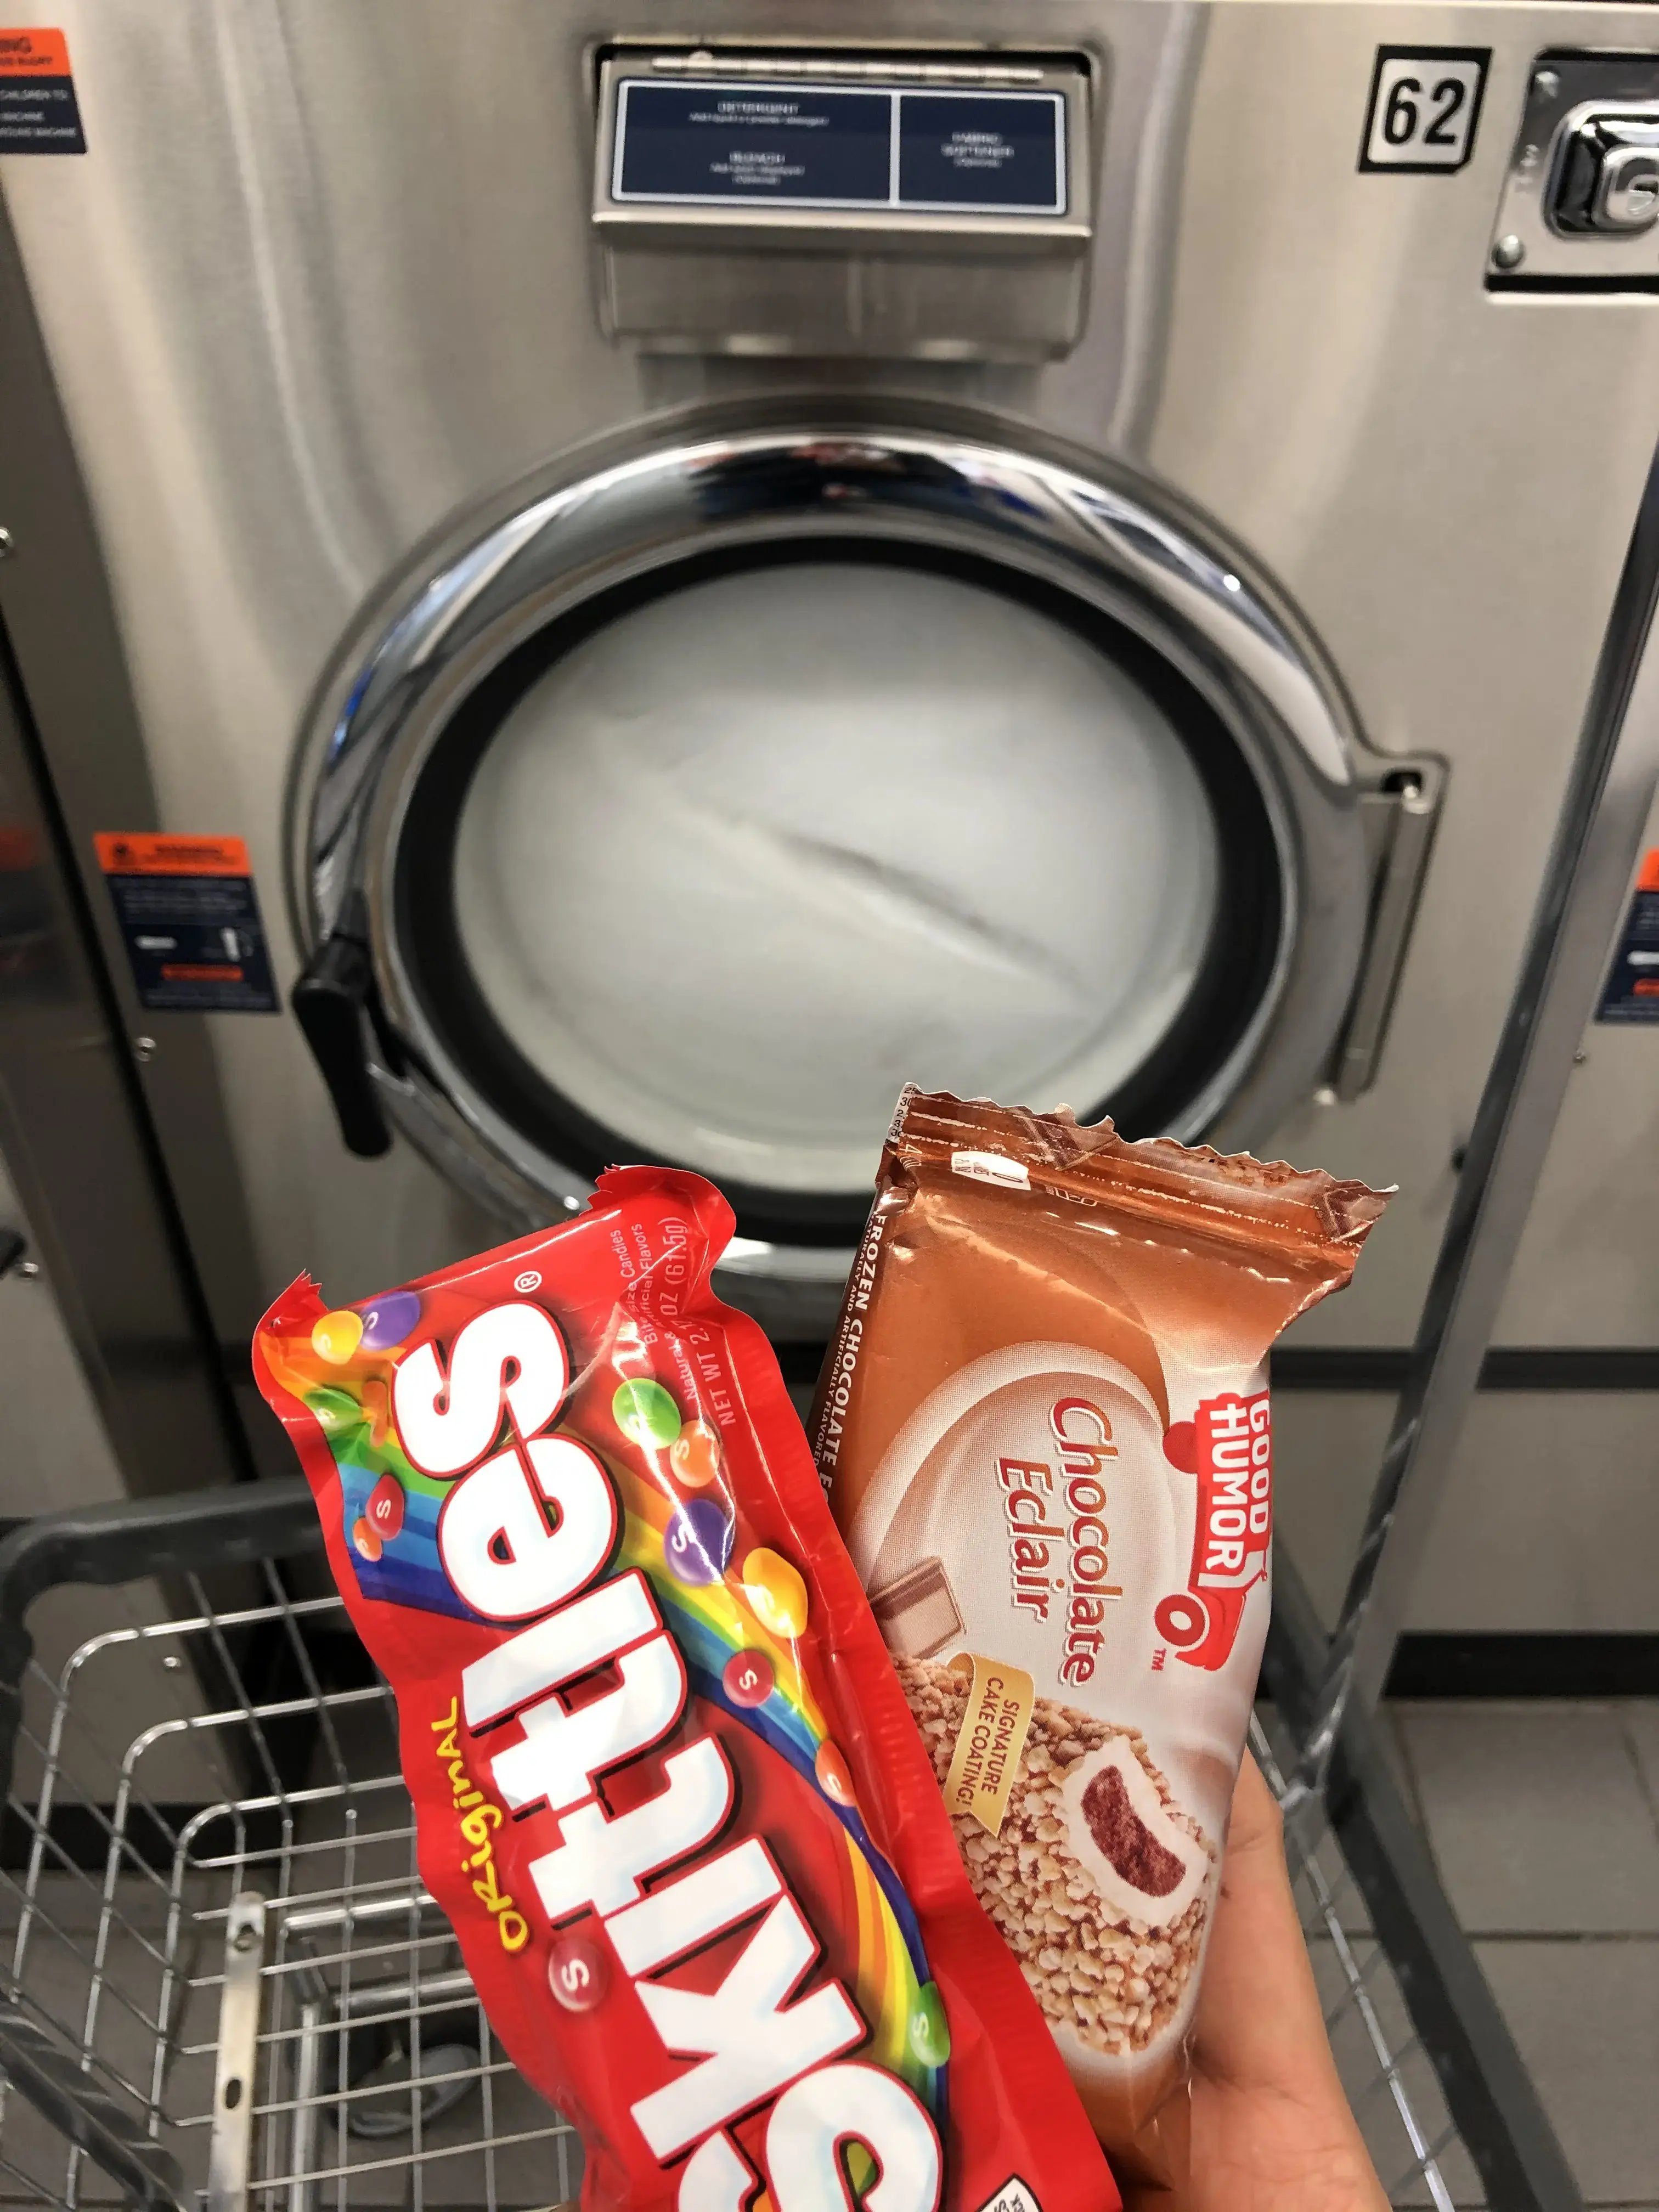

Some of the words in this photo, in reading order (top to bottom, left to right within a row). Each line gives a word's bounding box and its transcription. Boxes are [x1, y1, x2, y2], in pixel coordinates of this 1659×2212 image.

[1384, 77, 1465, 145] 62
[610, 1229, 636, 1278] Candies
[631, 1223, 653, 1271] Flavors
[658, 1217, 689, 1285] (61.5g)
[855, 1215, 888, 1310] FROZEN
[659, 1292, 679, 1316] OZ
[847, 1285, 857, 1312] AND
[664, 1330, 676, 1340] &
[696, 1352, 721, 1383] WT
[828, 1315, 851, 1398] ARTIFICIALLY
[668, 1342, 697, 1401] Natural
[822, 1318, 863, 1466] CHOCOLATE
[709, 1389, 736, 1426] NET
[1205, 1403, 1250, 1570] HUMOR
[1250, 1398, 1271, 1534] GOOD
[995, 1457, 1066, 1623] Eclair
[1049, 1397, 1124, 1686] Chocolate
[978, 1677, 1005, 1724] CAKE
[955, 1724, 991, 1807] COATING!
[981, 1699, 1020, 1796] SIGNATURE
